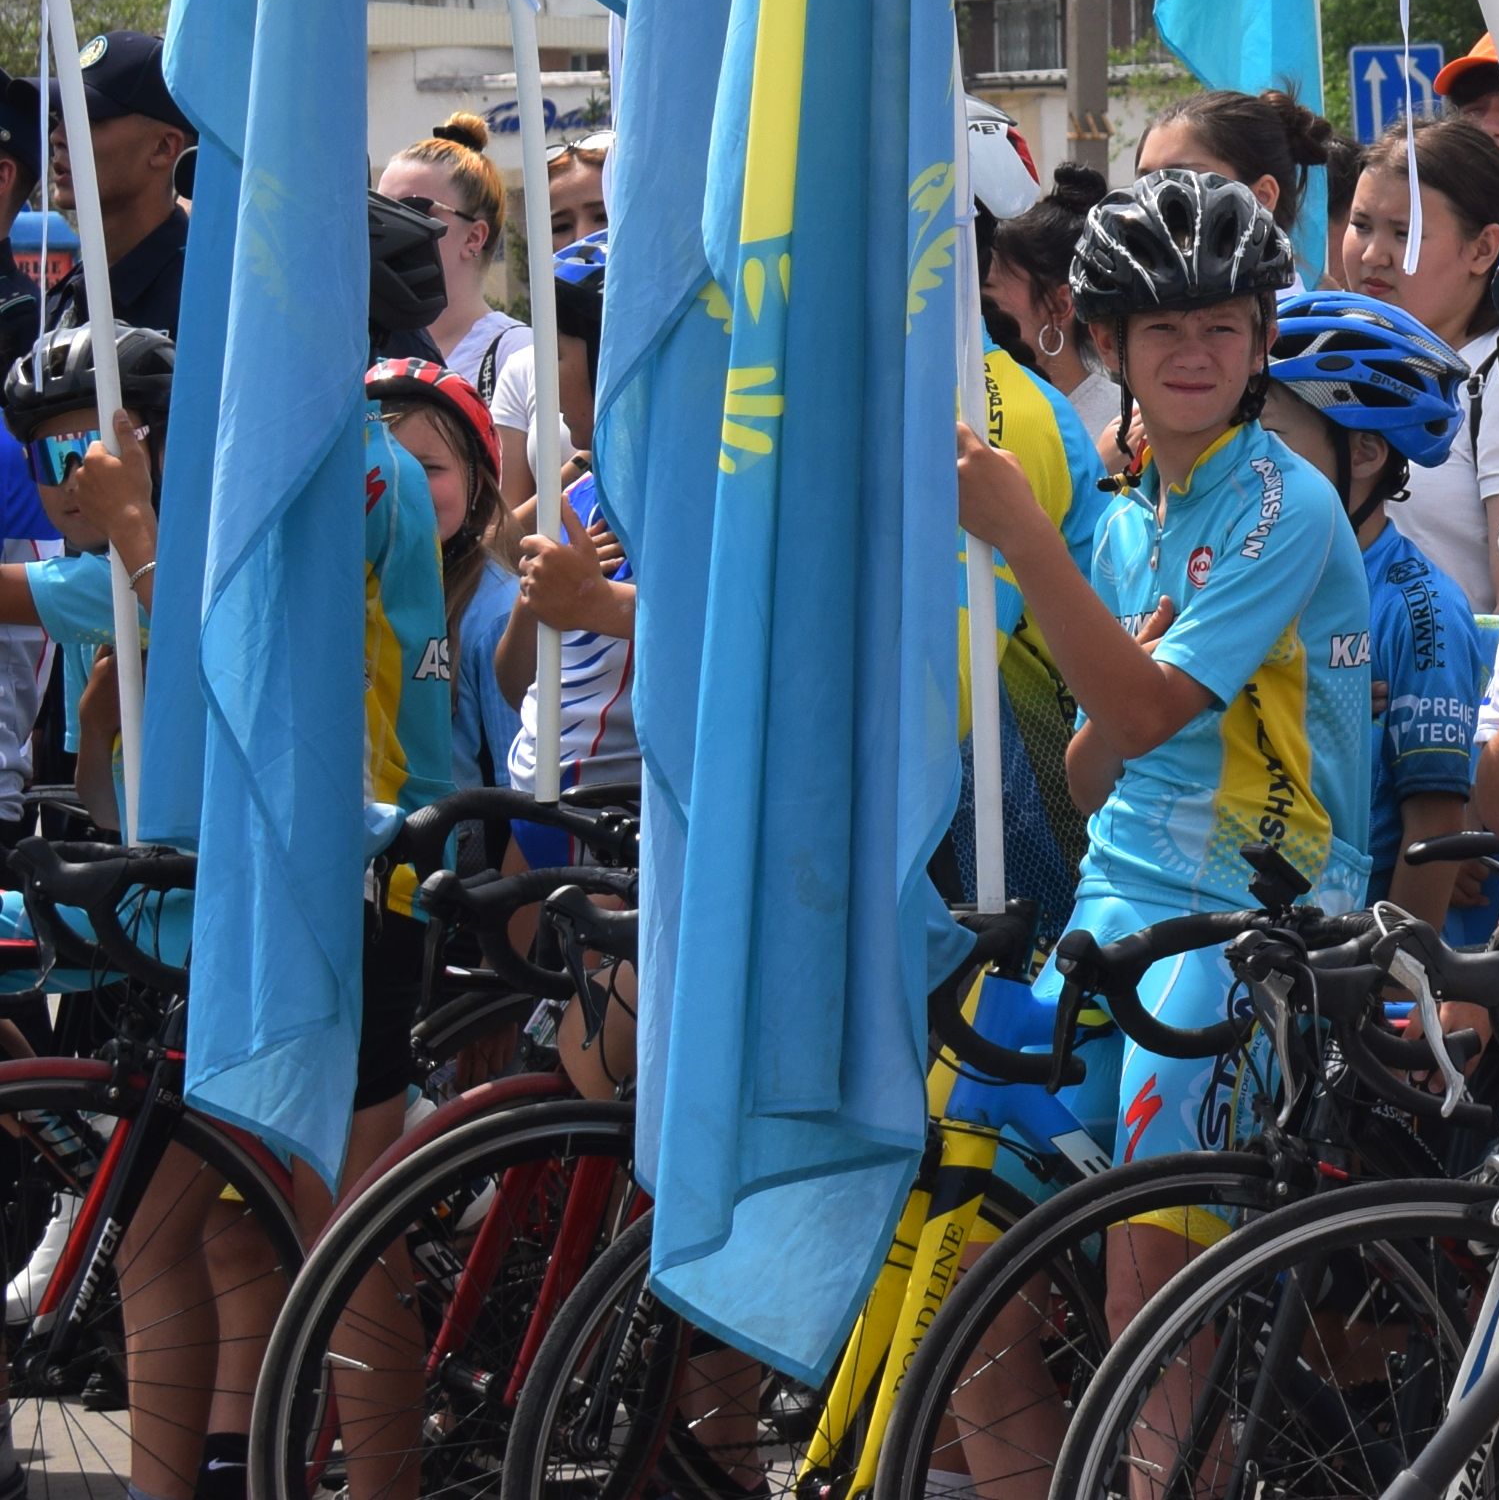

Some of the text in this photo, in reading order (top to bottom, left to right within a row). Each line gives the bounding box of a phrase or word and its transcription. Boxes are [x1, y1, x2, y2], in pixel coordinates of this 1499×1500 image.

[1404, 580, 1433, 673] SAMRUK
[1426, 579, 1446, 669] KAZYNA
[1416, 722, 1466, 745] TECH
[69, 1217, 123, 1322] TWITTER
